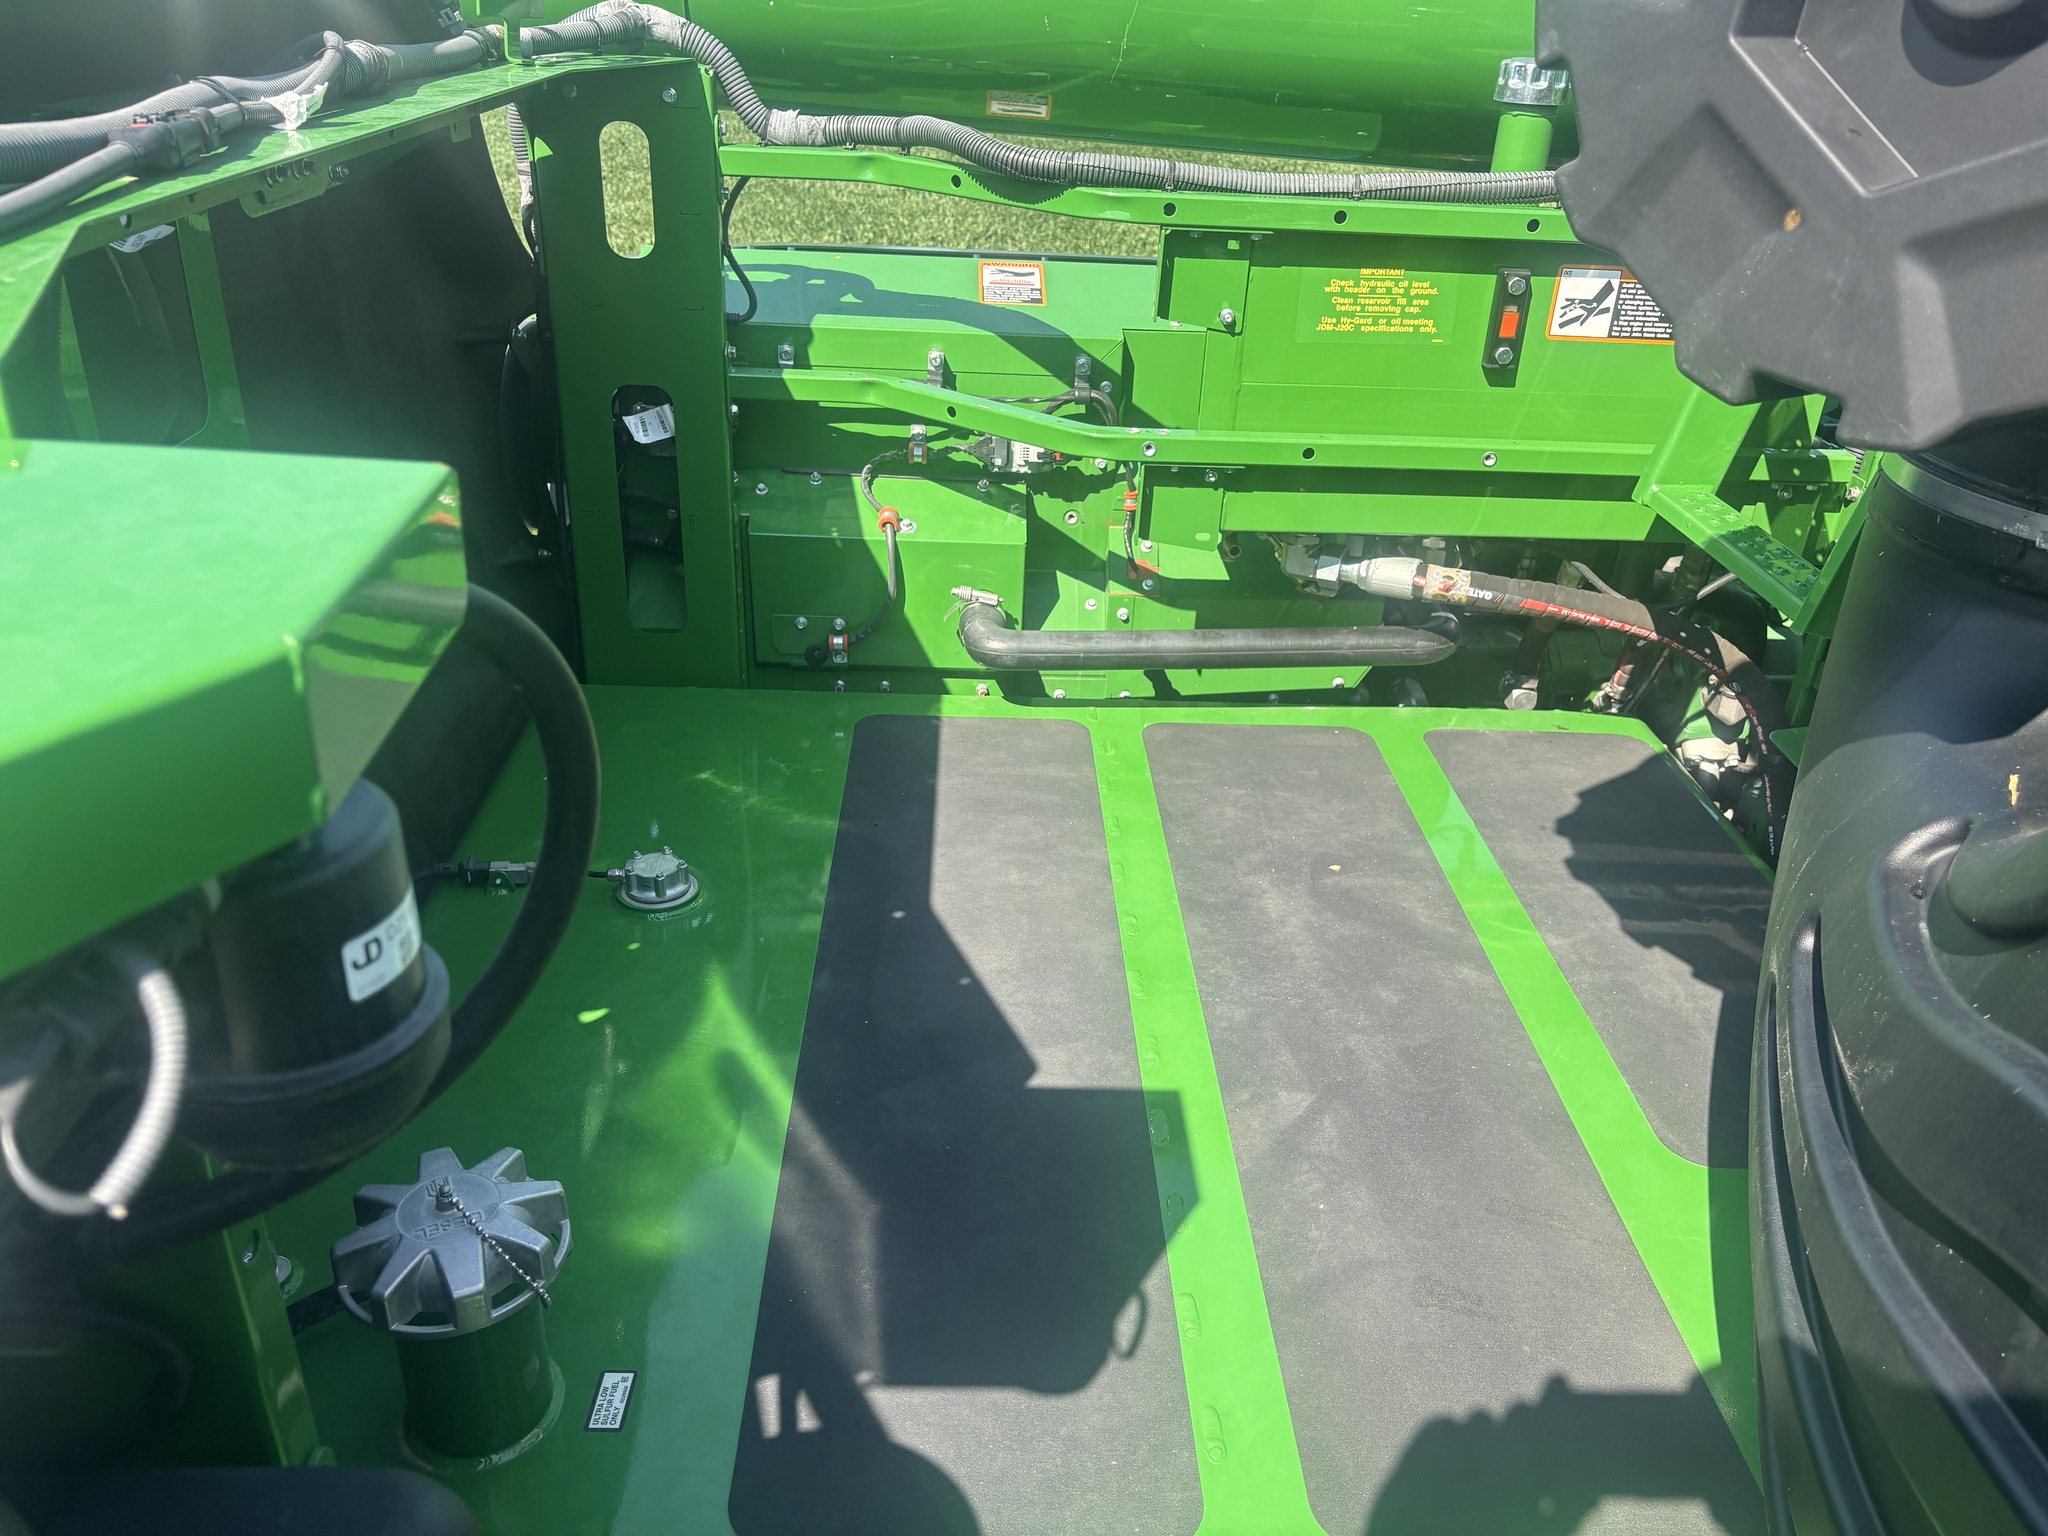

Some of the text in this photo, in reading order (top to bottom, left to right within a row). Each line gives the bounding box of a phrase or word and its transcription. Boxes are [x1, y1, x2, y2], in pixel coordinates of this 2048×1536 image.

[1360, 280, 1395, 288] hydraulic
[1403, 318, 1433, 327] meeting
[1361, 325, 1413, 333] specifications
[1420, 326, 1437, 334] only.
[592, 1386, 609, 1425] ULTRA LOW
[601, 1380, 620, 1425] SULFUR FUEL
[609, 1407, 620, 1425] ONLY
